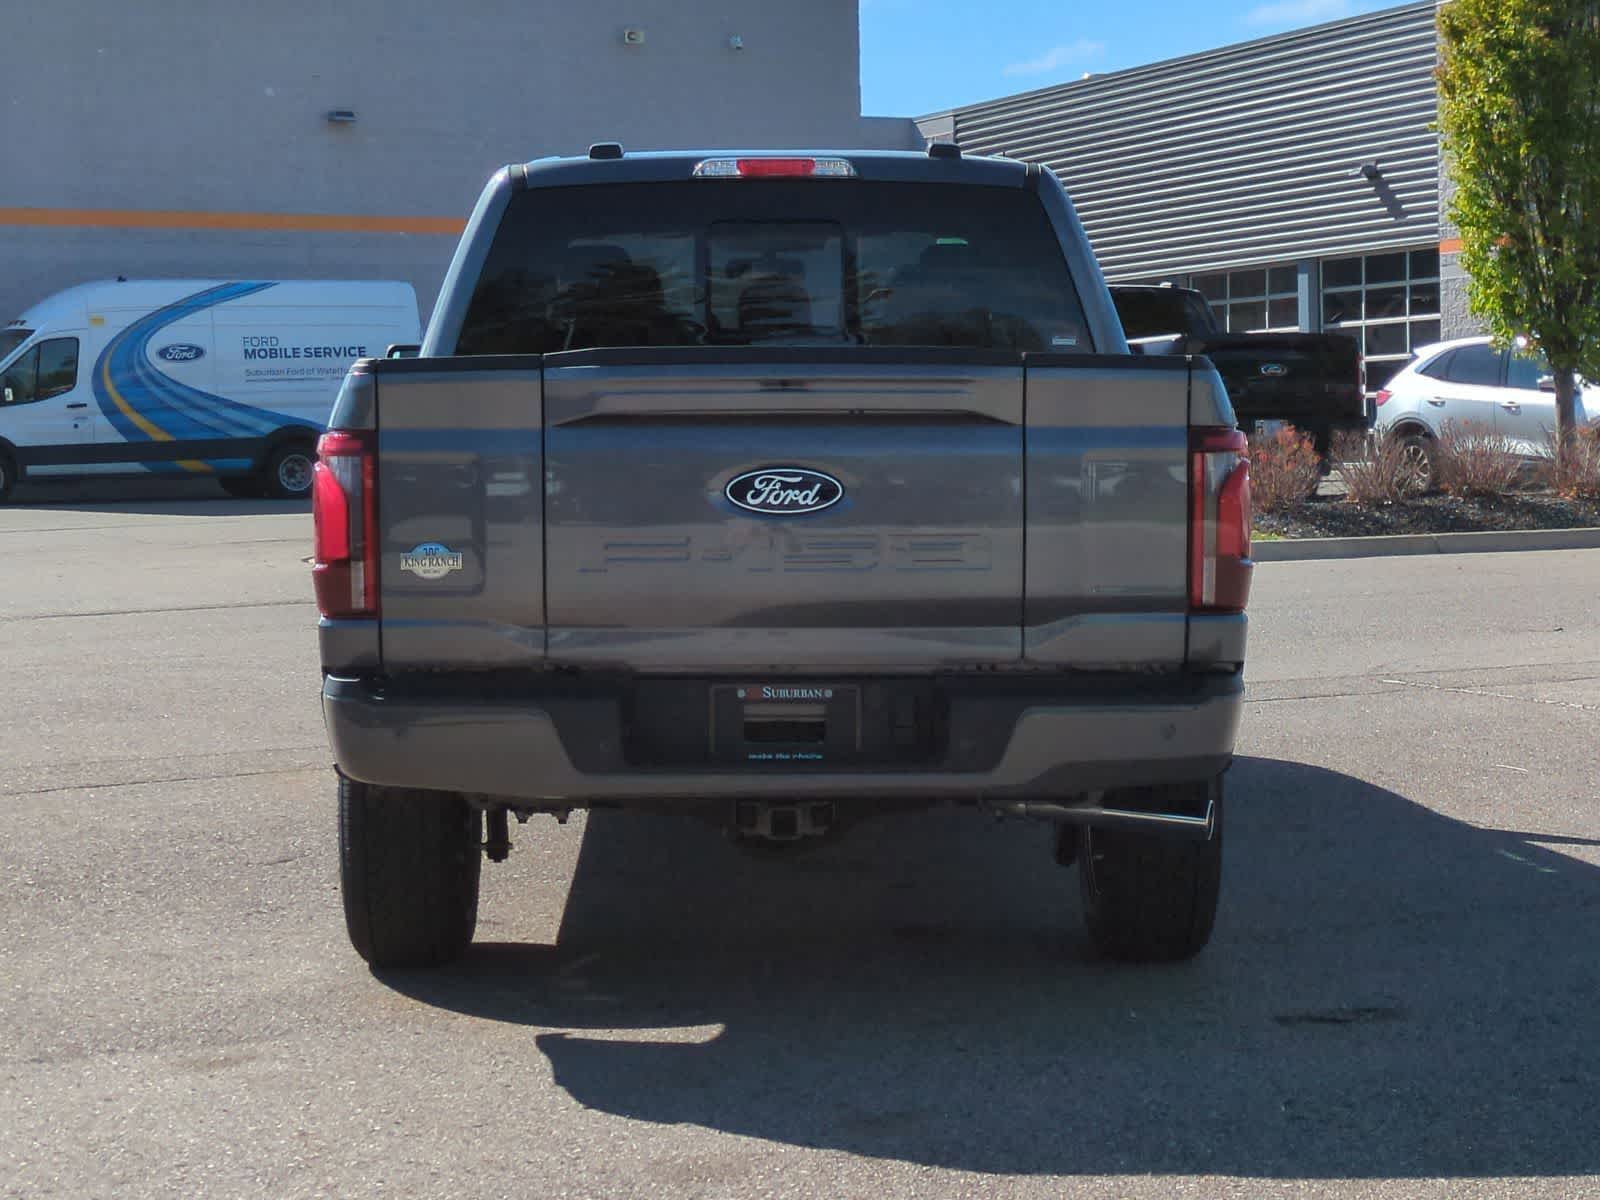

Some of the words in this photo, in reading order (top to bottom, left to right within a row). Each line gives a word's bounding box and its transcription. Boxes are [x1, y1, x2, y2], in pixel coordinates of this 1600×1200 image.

[242, 335, 279, 347] FORD
[164, 344, 198, 361] Ford
[243, 347, 302, 360] MOBILE
[303, 346, 367, 358] SERVICE
[746, 474, 822, 506] Ford
[404, 557, 428, 568] KING
[428, 556, 458, 568] RANCH
